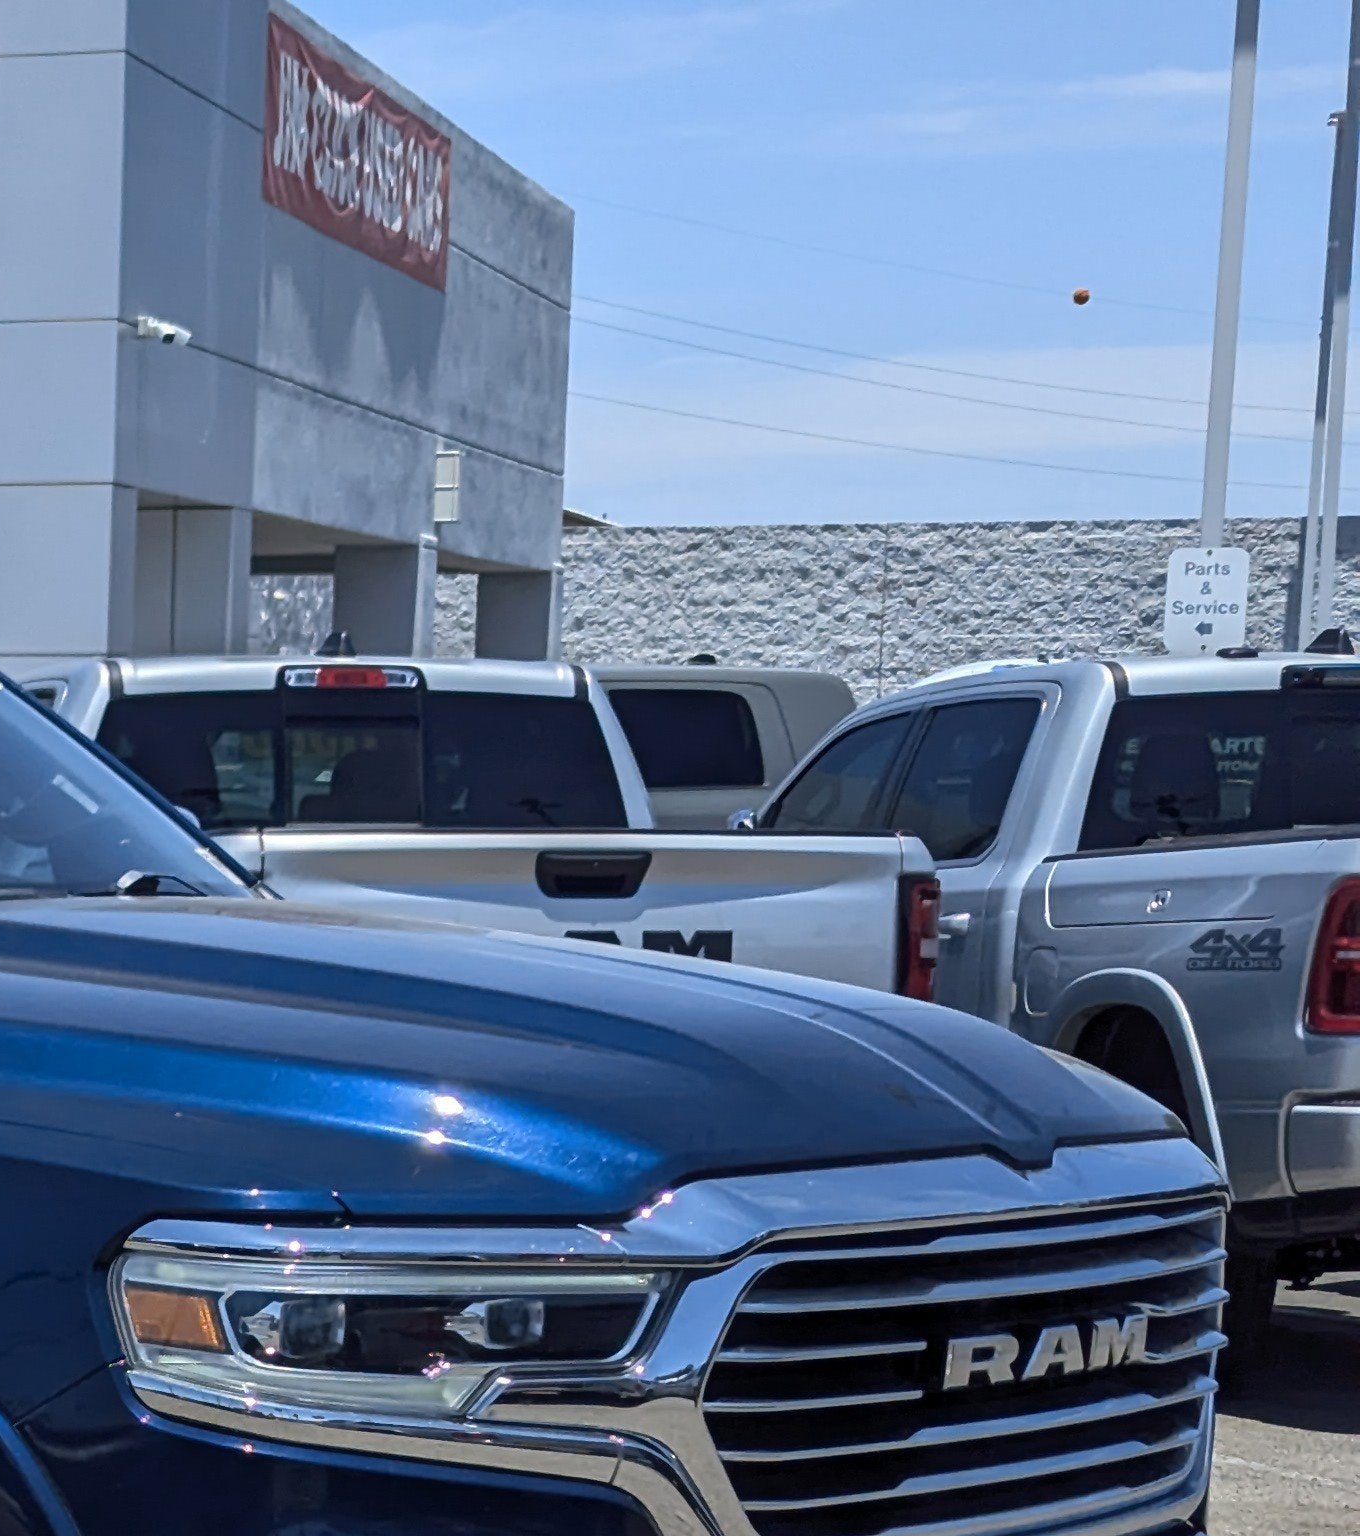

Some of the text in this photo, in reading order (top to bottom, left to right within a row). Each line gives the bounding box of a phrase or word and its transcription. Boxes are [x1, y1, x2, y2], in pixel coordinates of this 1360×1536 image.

[1184, 561, 1231, 576] Parts
[1200, 580, 1212, 595] &
[1171, 600, 1240, 615] Service
[941, 1313, 1149, 1391] RAM
